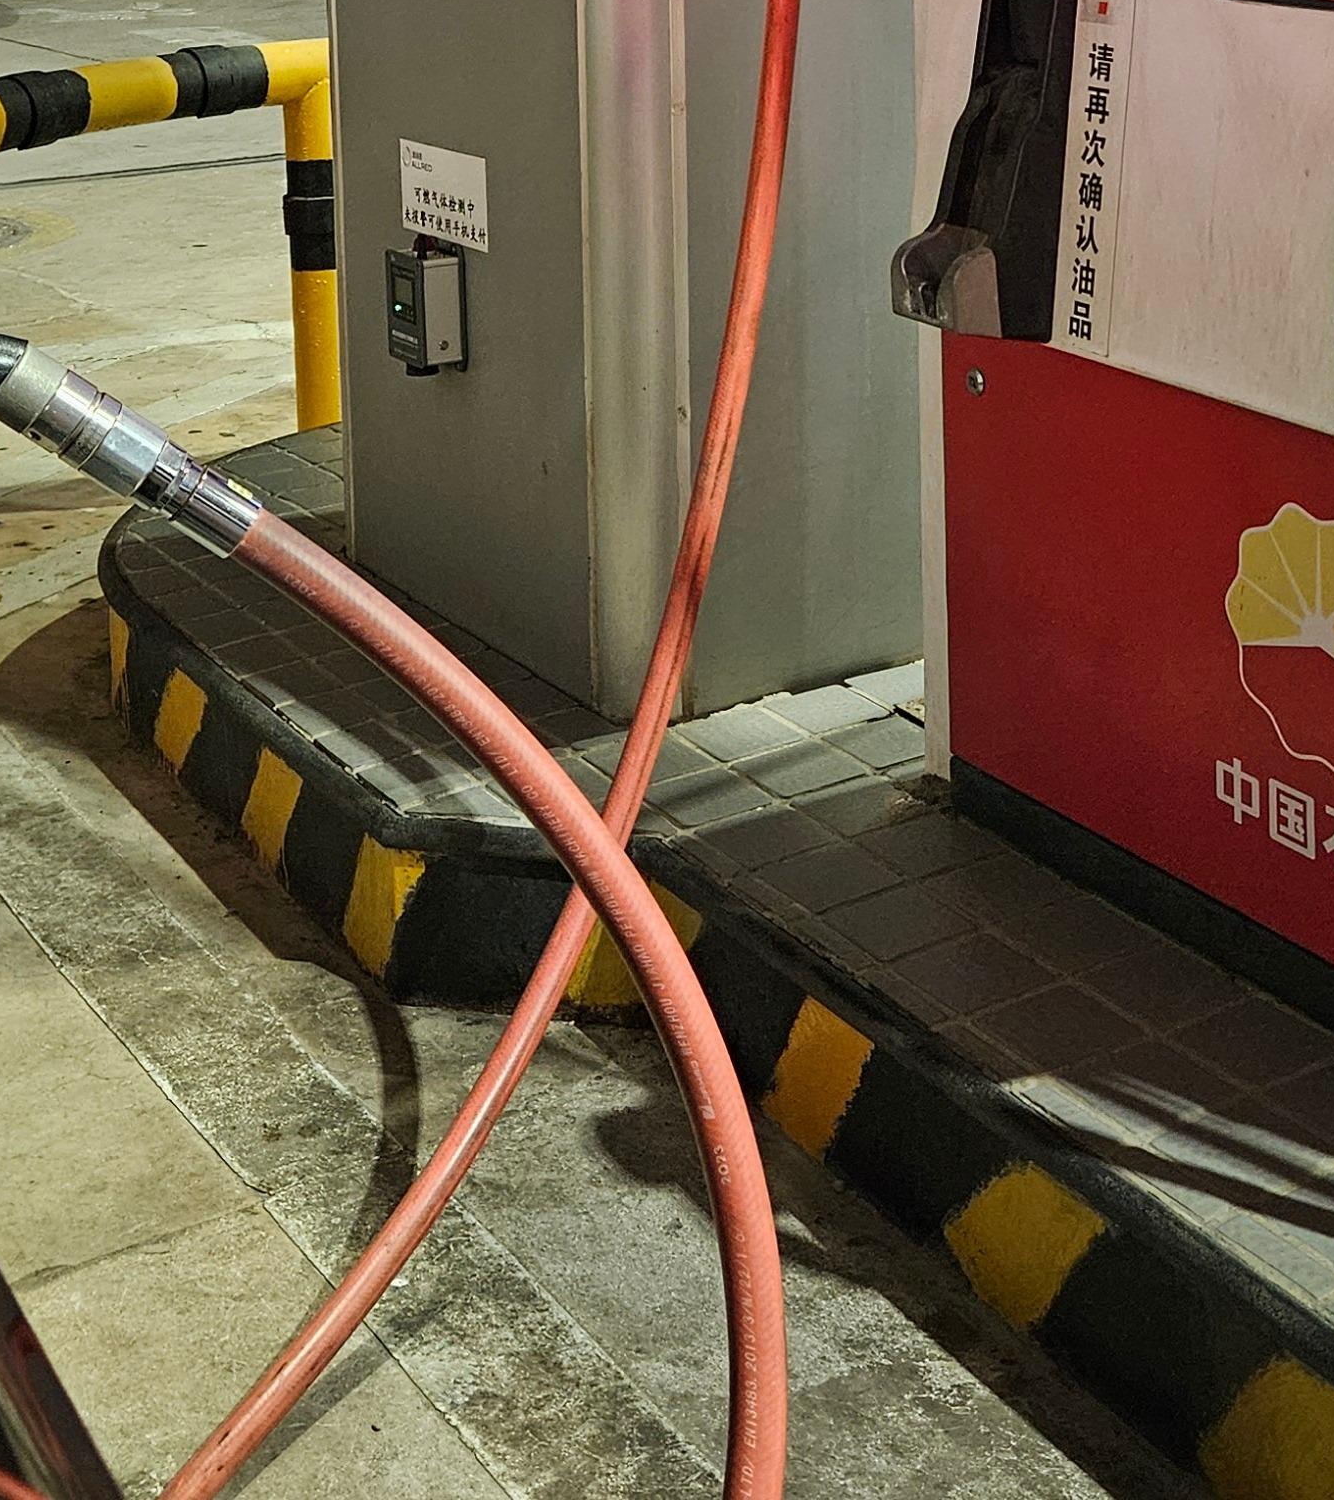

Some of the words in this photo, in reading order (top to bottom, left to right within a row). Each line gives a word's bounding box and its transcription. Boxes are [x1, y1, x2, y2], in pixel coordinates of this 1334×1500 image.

[1068, 43, 1115, 341] 请再次确认油品
